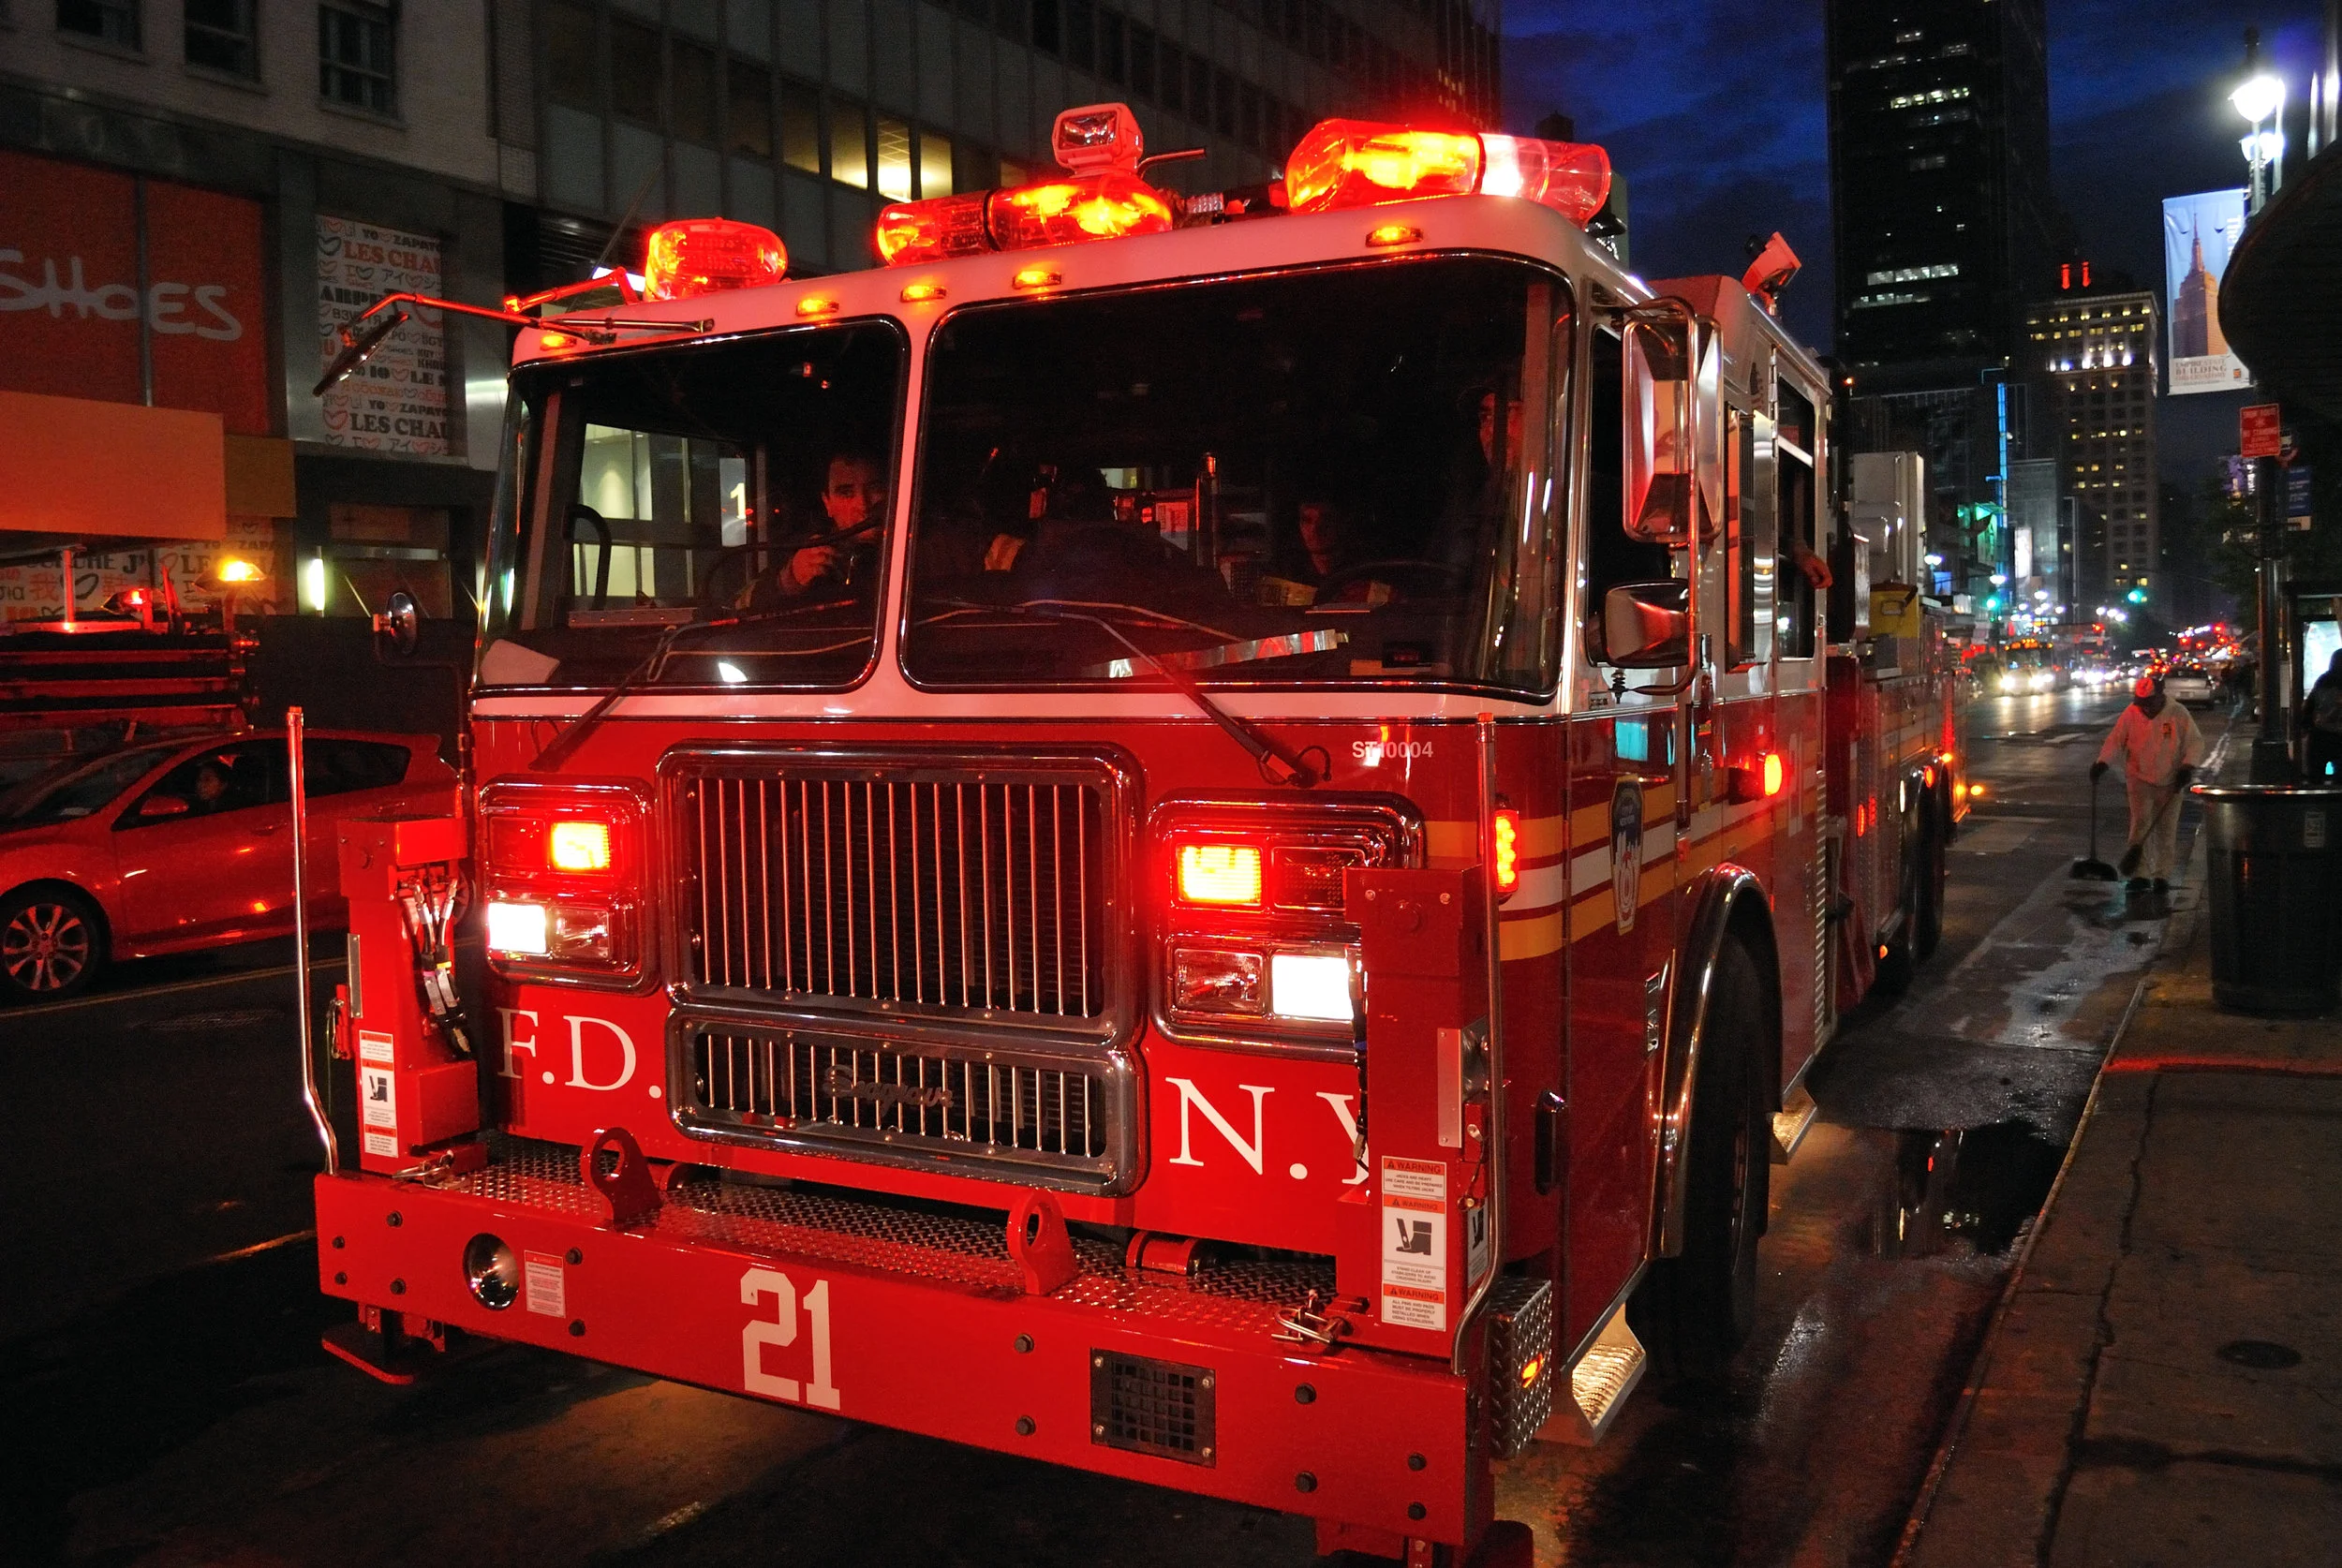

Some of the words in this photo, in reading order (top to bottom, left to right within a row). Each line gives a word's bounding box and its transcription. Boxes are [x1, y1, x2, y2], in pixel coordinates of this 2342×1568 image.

[344, 240, 383, 264] LES
[2176, 365, 2227, 375] BUILDING
[368, 400, 385, 410] YO
[350, 413, 391, 434] LES
[1352, 740, 1434, 759] ST10004
[497, 1008, 662, 1100] F.D.
[1397, 1161, 1441, 1174] WARNING
[1401, 1201, 1438, 1211] WARNING
[1399, 1288, 1439, 1301] WARNING
[740, 1267, 840, 1411] 21
